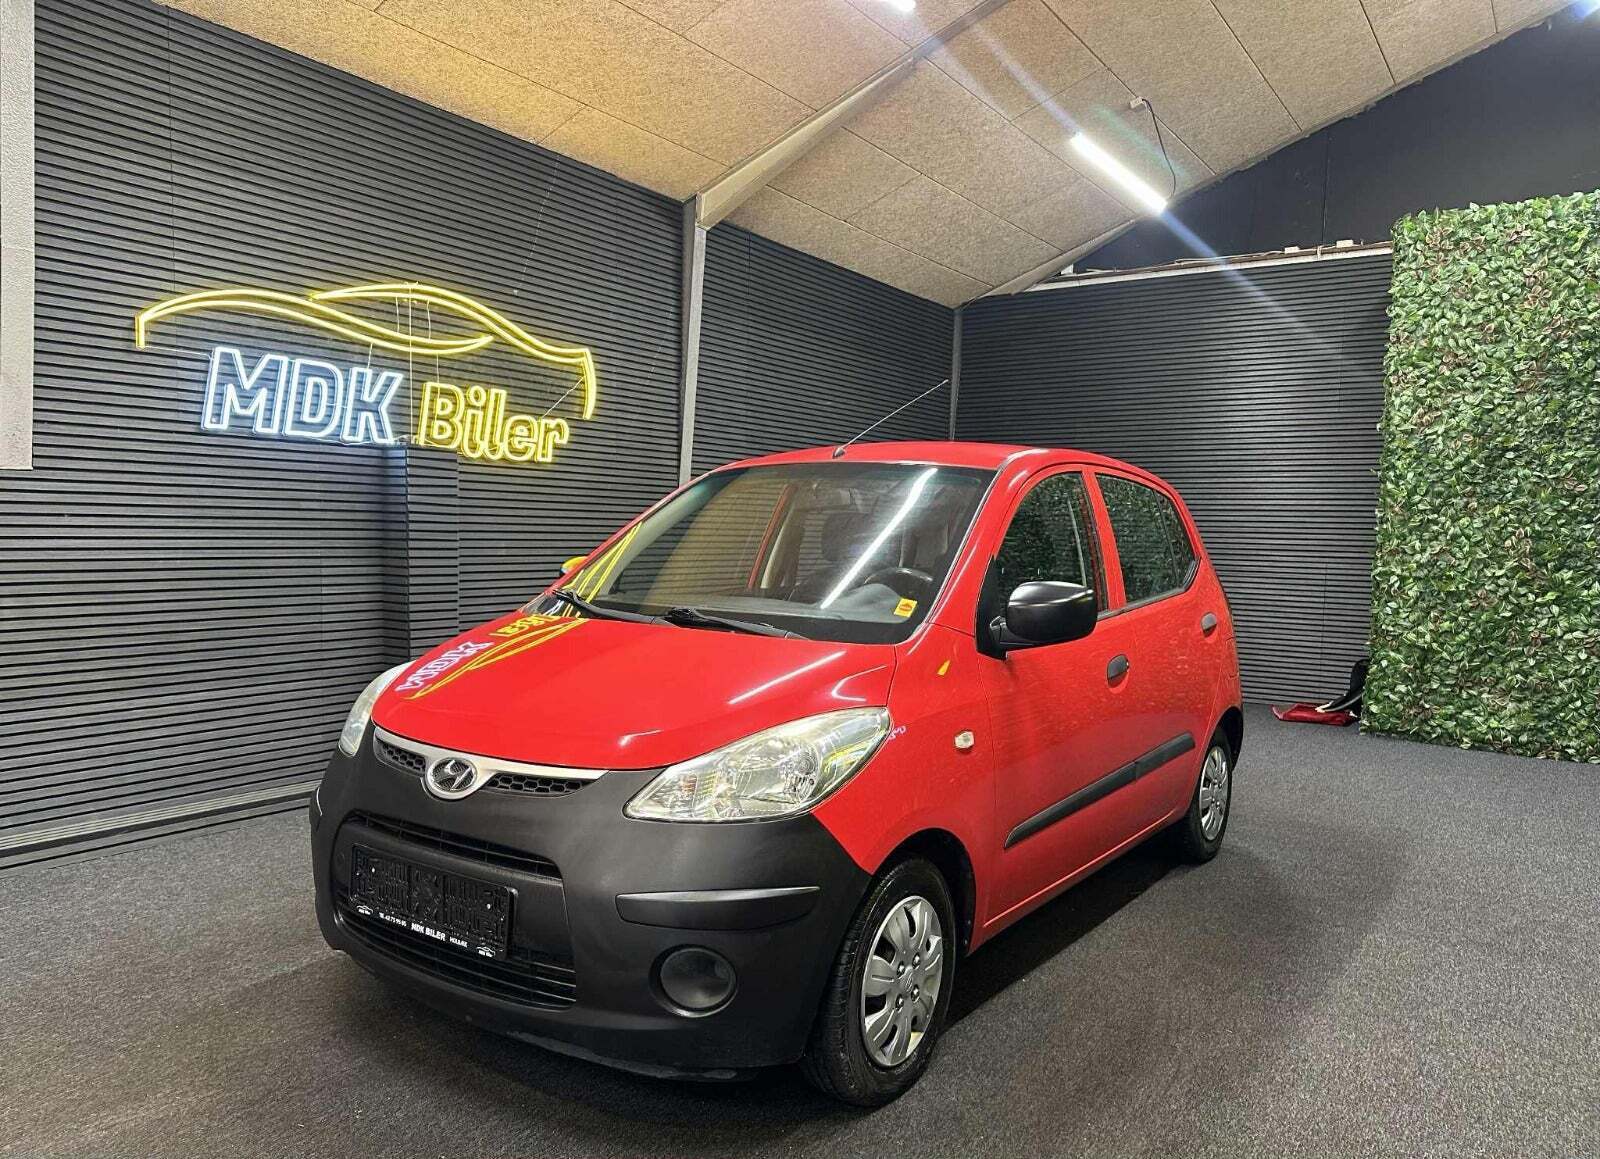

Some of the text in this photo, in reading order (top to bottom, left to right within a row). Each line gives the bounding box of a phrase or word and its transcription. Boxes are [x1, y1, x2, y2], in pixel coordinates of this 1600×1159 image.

[201, 346, 570, 464] MDK Biler
[425, 927, 446, 941] BILER
